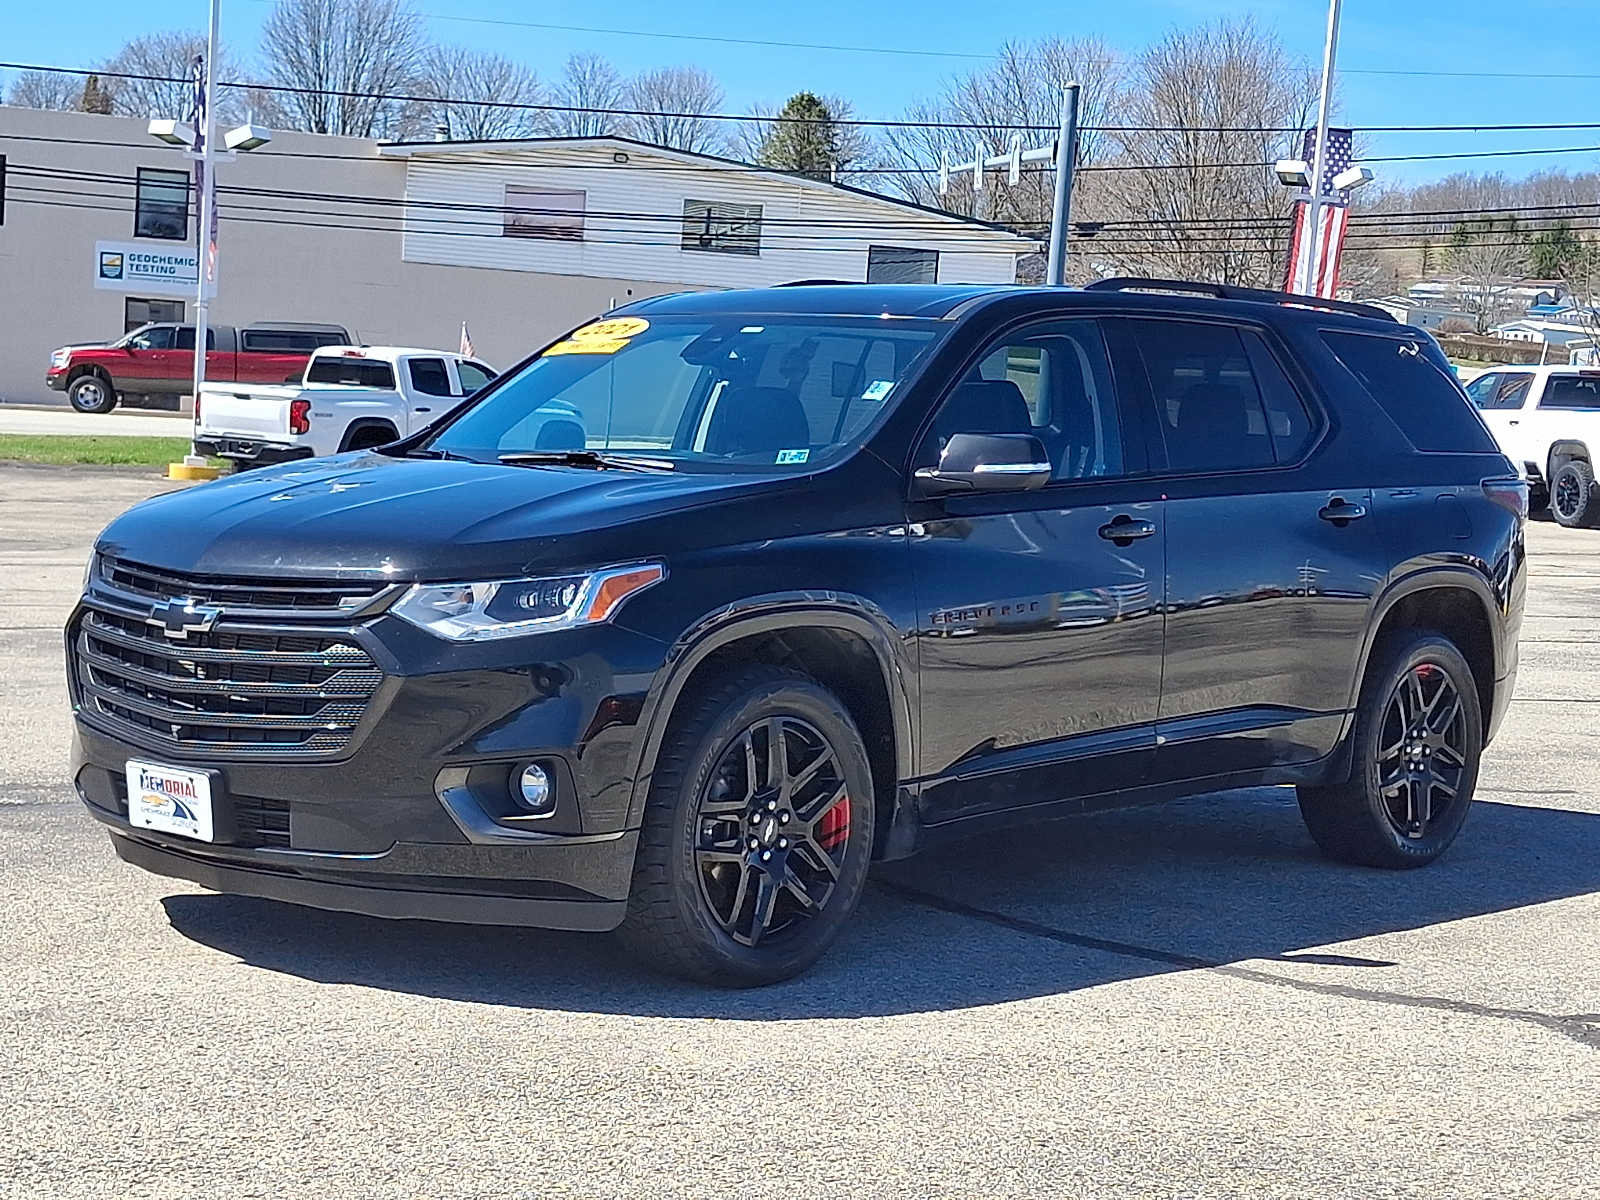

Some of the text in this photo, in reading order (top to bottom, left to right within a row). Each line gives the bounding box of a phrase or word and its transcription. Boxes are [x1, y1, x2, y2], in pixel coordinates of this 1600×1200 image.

[128, 253, 198, 267] GEOCHEMIC
[128, 263, 176, 275] TESTING
[140, 774, 198, 798] MEMORIAL
